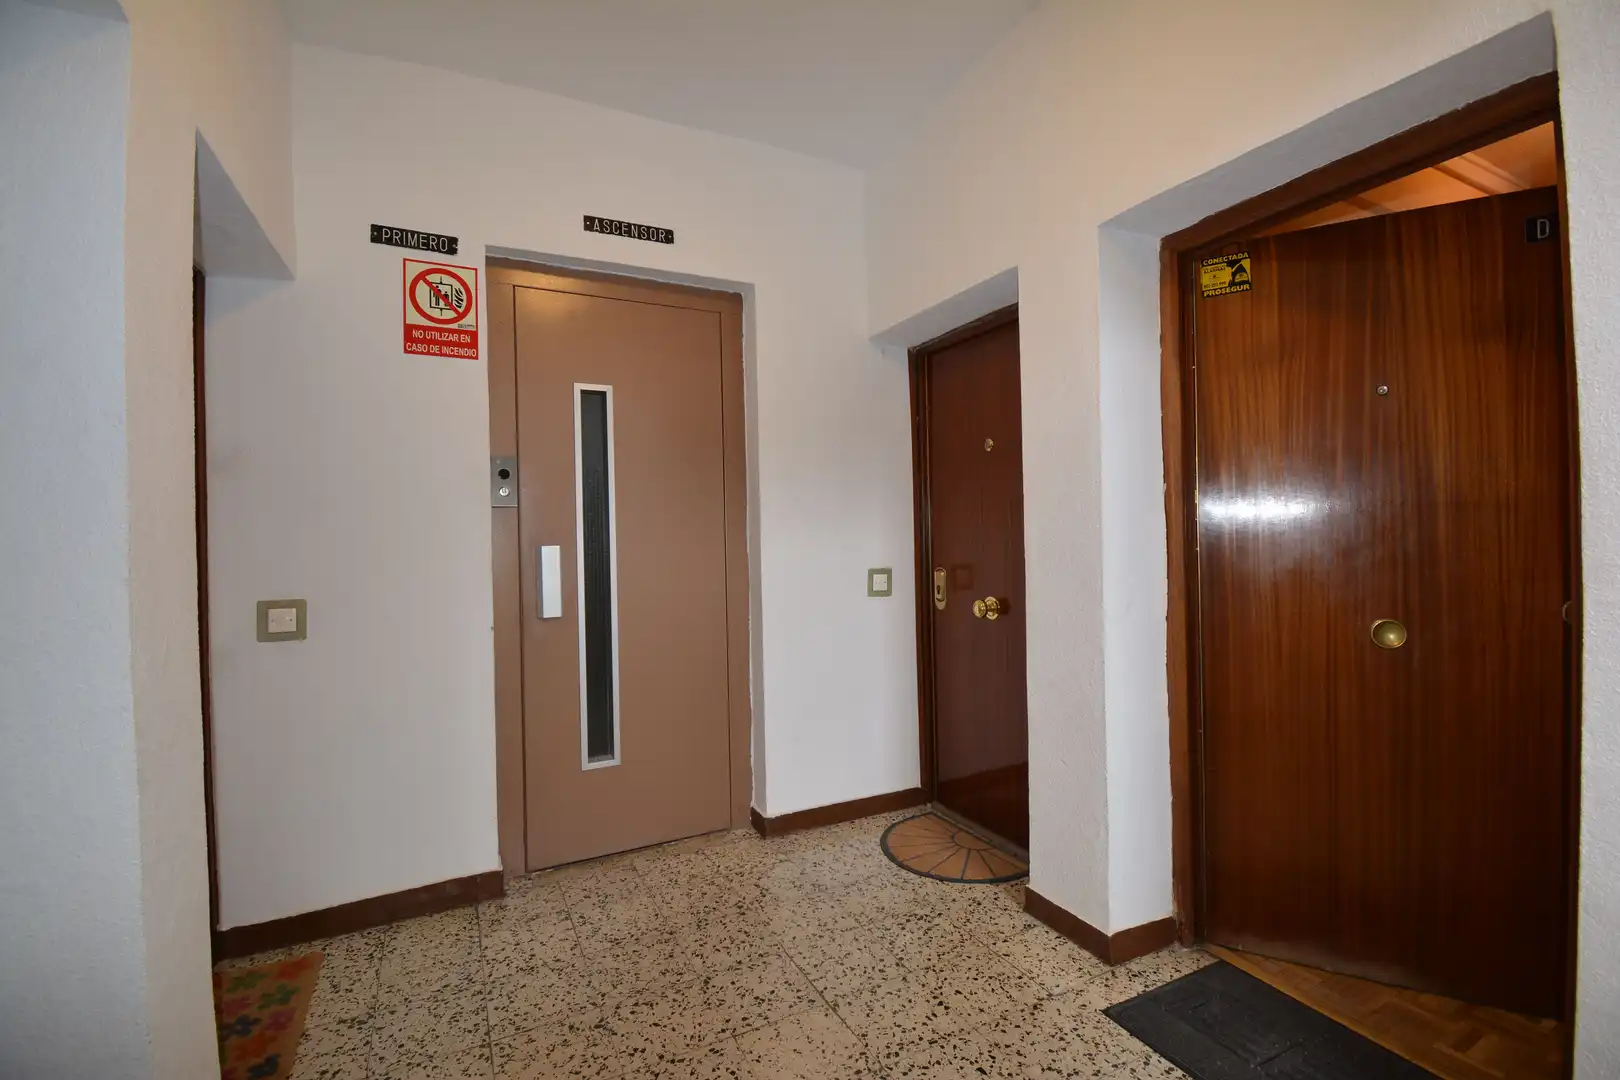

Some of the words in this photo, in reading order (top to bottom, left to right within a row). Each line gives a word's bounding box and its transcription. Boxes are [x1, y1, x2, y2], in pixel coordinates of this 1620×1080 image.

[593, 218, 666, 242] ASCENSOR
[1537, 219, 1550, 239] D
[382, 227, 448, 252] PRIMERO
[1203, 252, 1249, 266] CONECTADA
[1203, 284, 1250, 297] PROSEGUR
[412, 329, 424, 338] NO
[425, 331, 459, 342] UTILIZAR
[460, 334, 471, 343] EN
[406, 342, 428, 352] CASO
[429, 345, 440, 353] DE
[441, 346, 477, 357] INCENDIO
